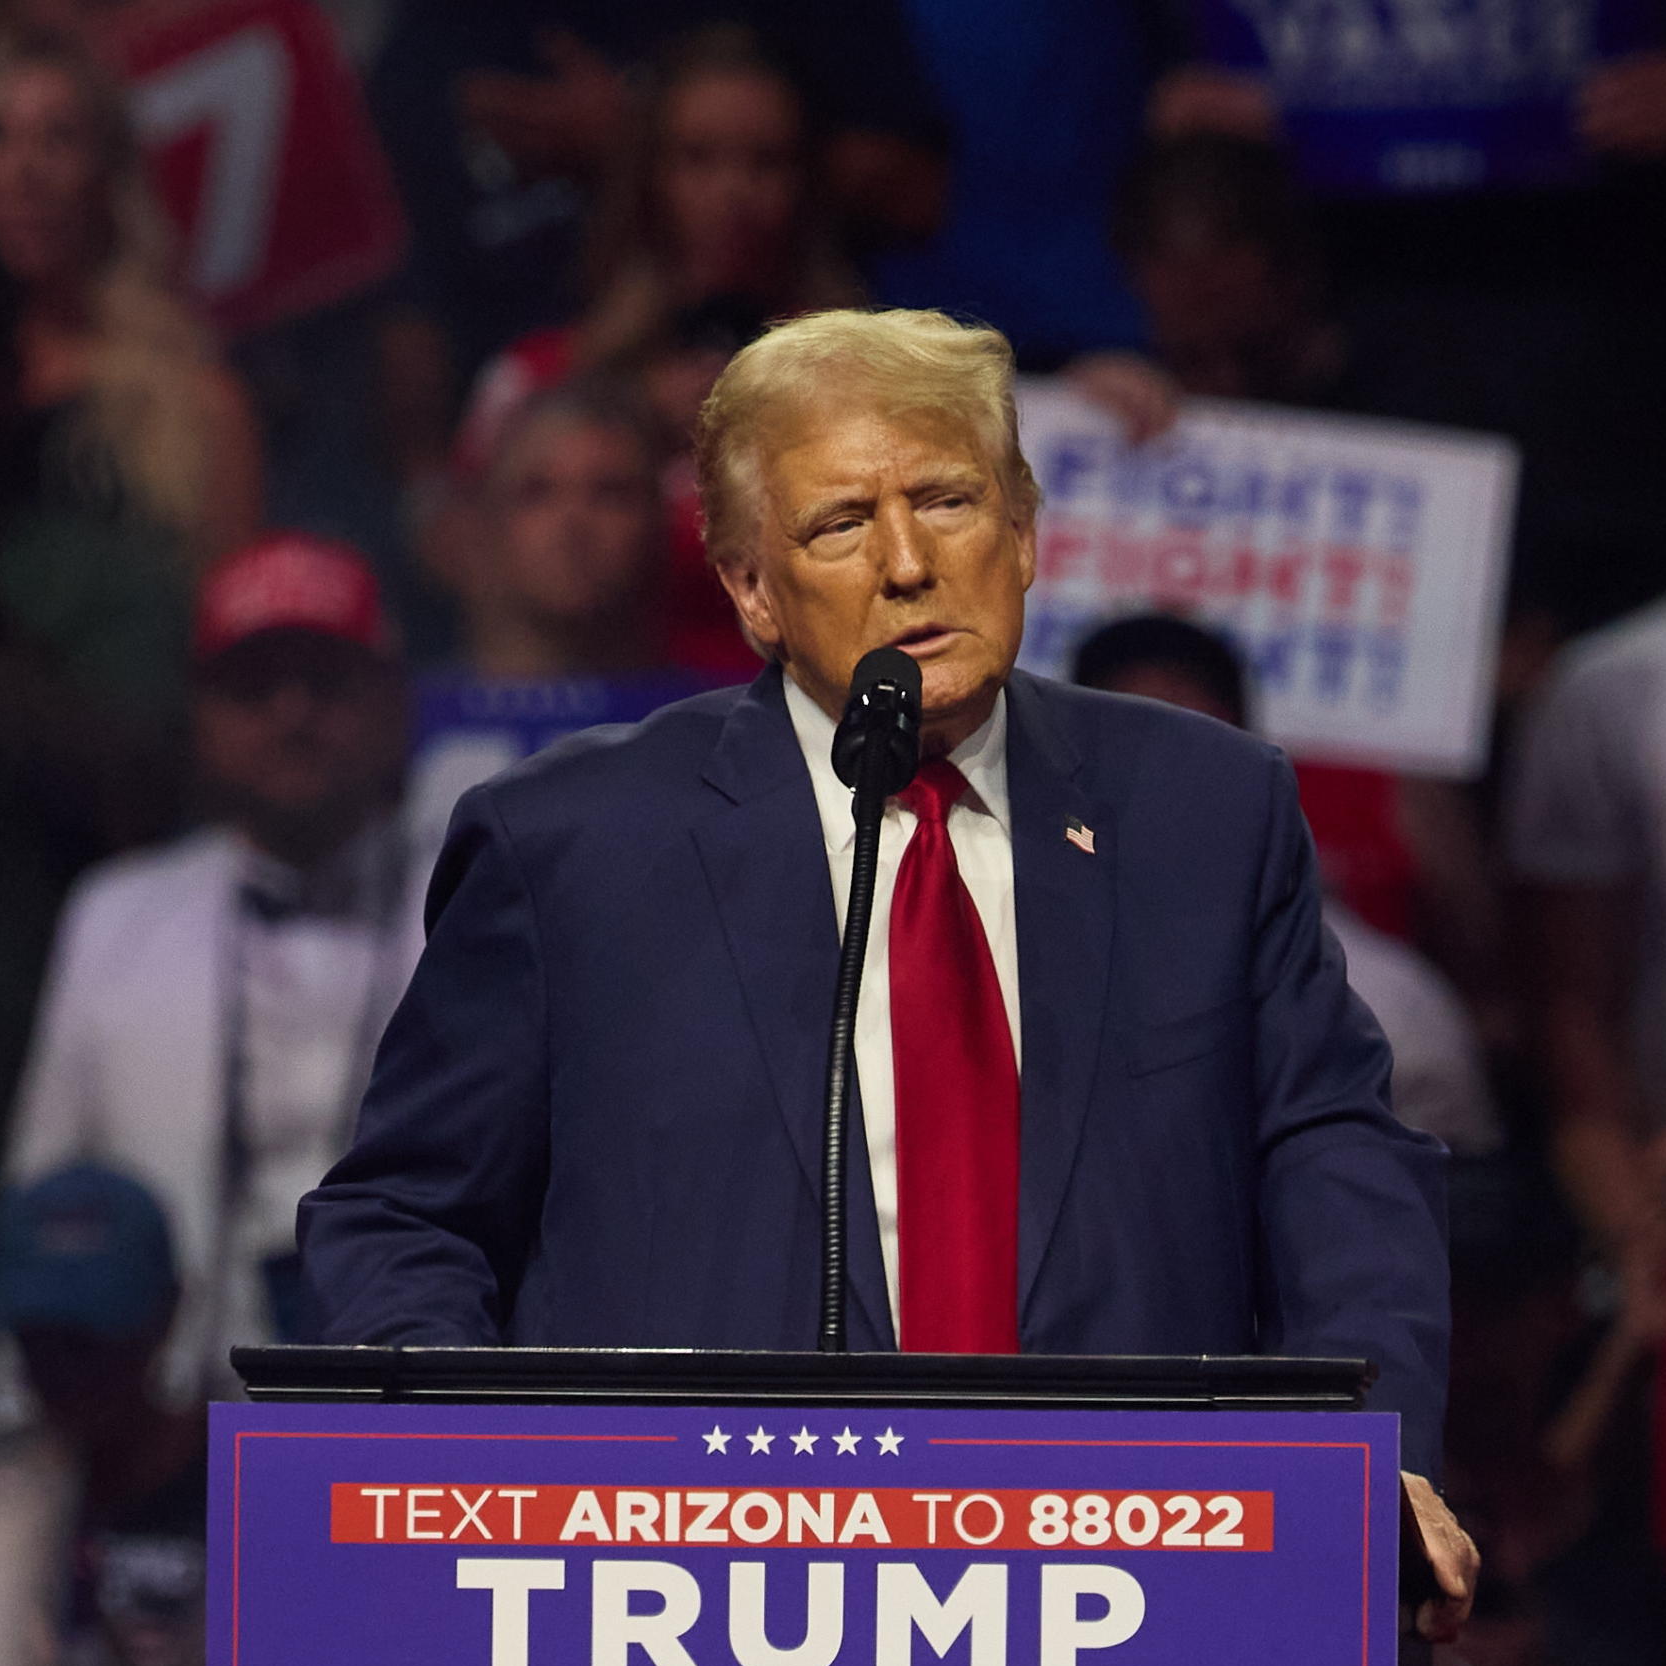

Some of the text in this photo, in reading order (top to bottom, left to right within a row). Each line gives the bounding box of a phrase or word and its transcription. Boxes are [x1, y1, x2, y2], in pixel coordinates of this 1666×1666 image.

[360, 1488, 1244, 1547] TEXT ARIZONA TO 88022
